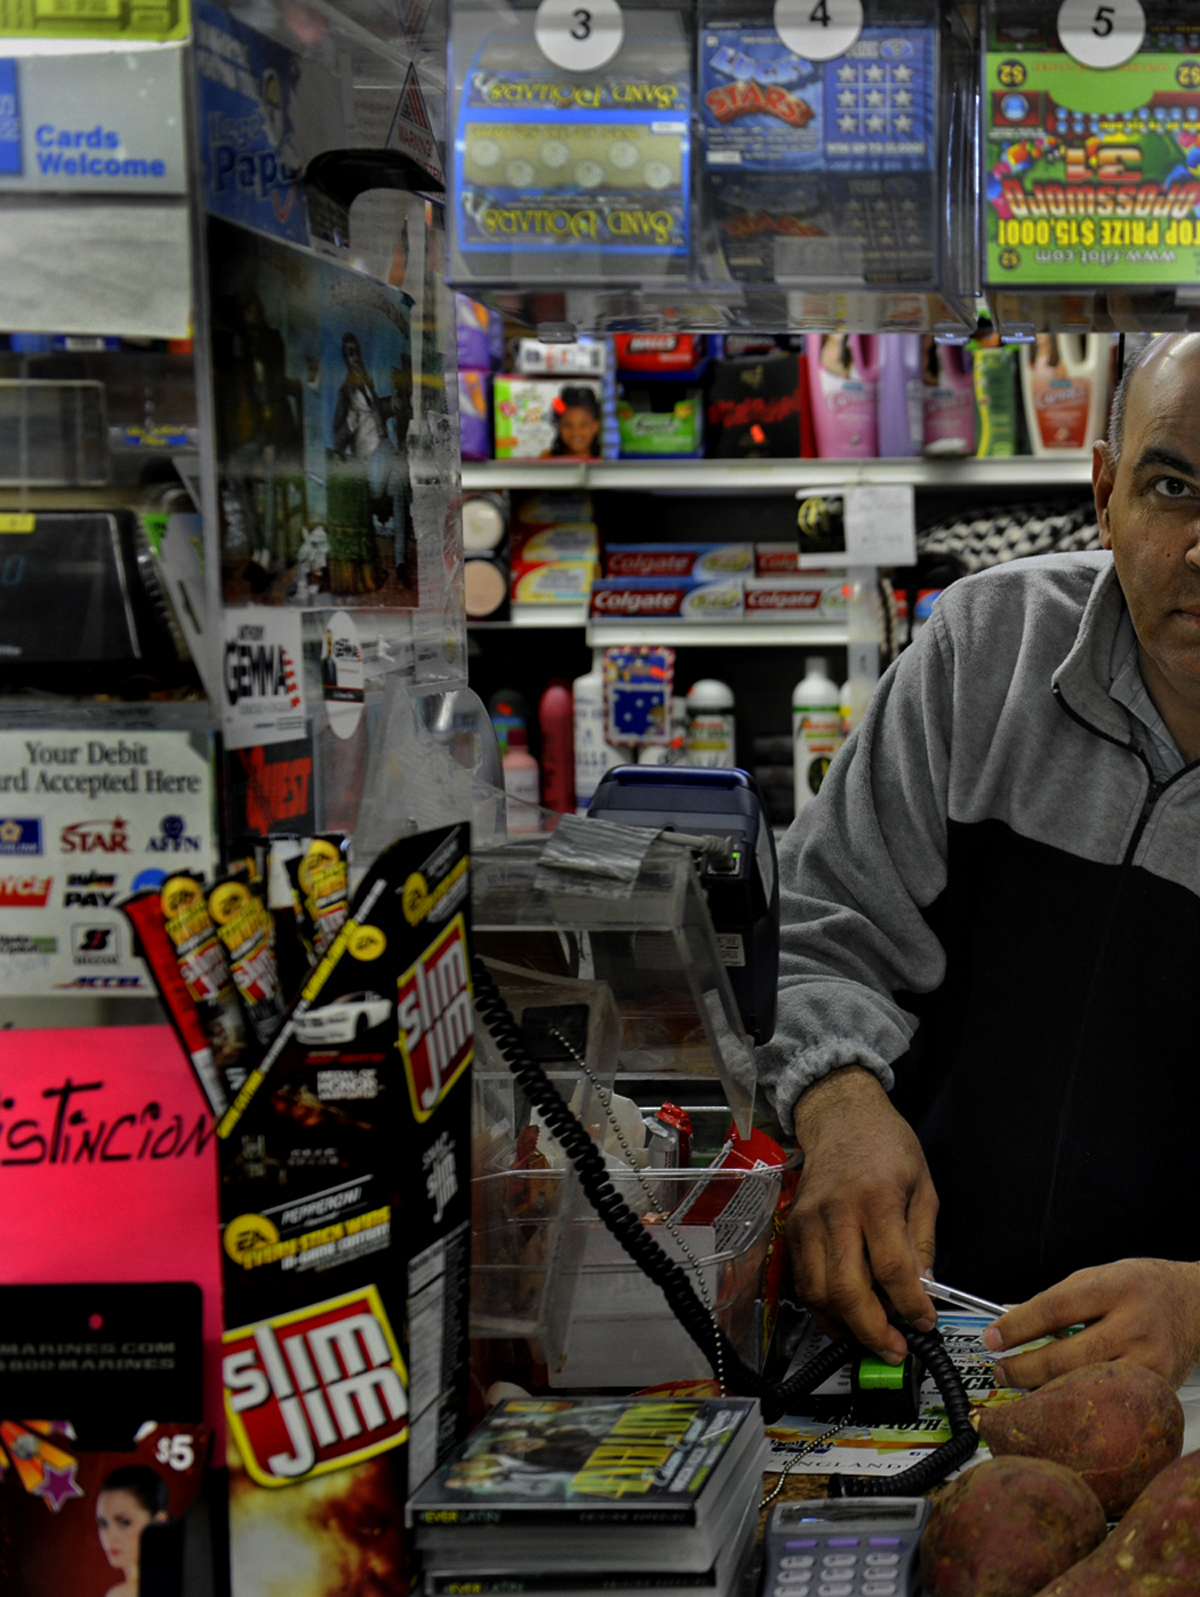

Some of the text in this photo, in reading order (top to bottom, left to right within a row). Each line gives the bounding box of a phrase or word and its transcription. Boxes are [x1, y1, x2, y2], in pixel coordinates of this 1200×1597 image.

[572, 9, 592, 41] 3
[810, 0, 830, 28] 4
[1091, 9, 1115, 39] 5
[1000, 64, 1025, 84] $2
[36, 124, 120, 150] Cards
[37, 152, 167, 178] Welcome
[1001, 178, 1200, 217] CROSSWORD
[482, 208, 675, 245] SAND DOLLARS
[998, 217, 1096, 247] $15,000!
[1099, 219, 1160, 247] PRIZE
[1034, 248, 1177, 267] www.rilot.com
[608, 554, 689, 572] Colgate
[594, 590, 677, 612] Colgate
[747, 590, 819, 609] Colgate
[25, 740, 149, 766] Your Debit
[34, 768, 139, 799] Accepted
[144, 771, 203, 793] Here
[60, 831, 131, 853] STAR
[63, 892, 117, 908] PAY
[74, 976, 141, 989] ACCEL
[57, 1357, 177, 1371] MARINES
[155, 1433, 195, 1472] $5
